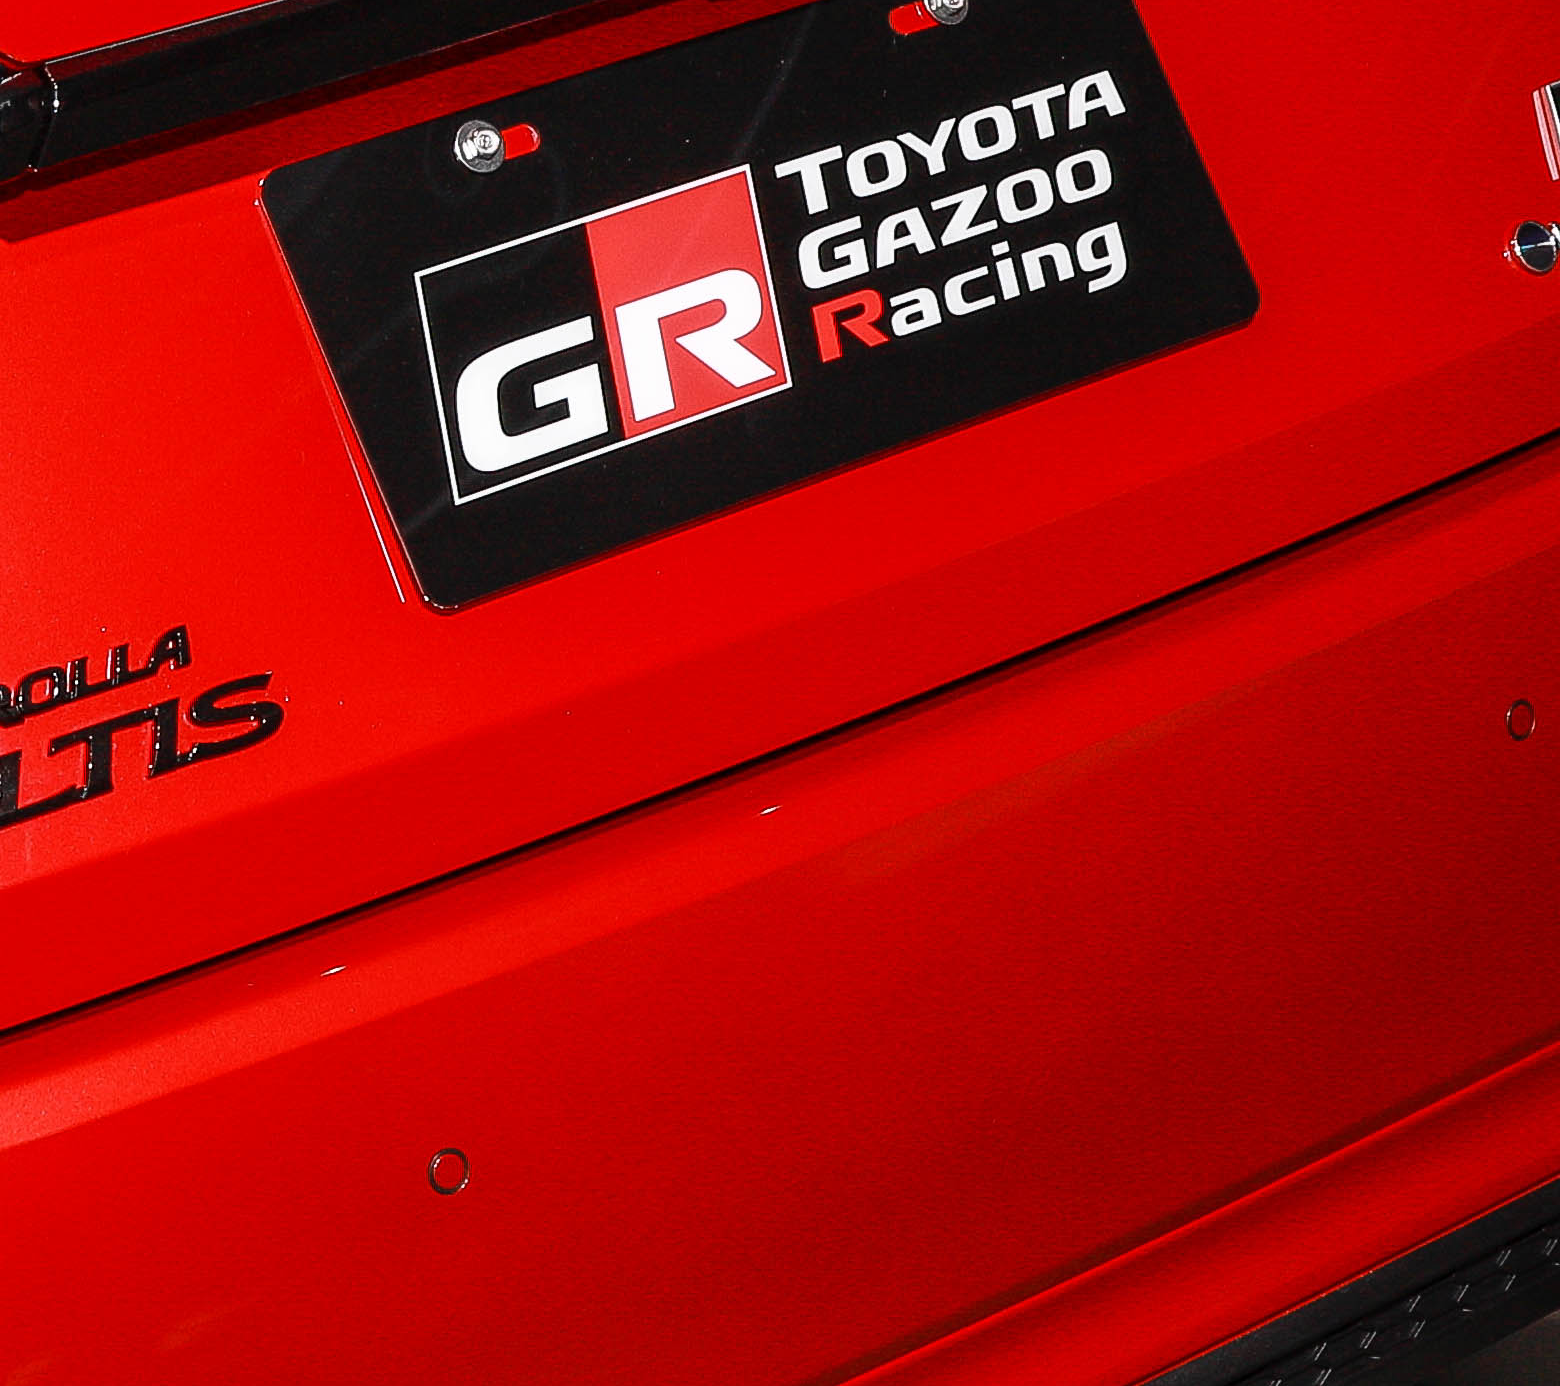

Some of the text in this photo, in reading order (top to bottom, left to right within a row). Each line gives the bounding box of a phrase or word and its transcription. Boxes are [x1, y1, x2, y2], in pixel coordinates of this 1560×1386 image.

[776, 69, 1127, 216] TOYOTA
[797, 147, 1115, 291] GAZOO
[811, 221, 1129, 363] Racing
[454, 267, 779, 474] GR
